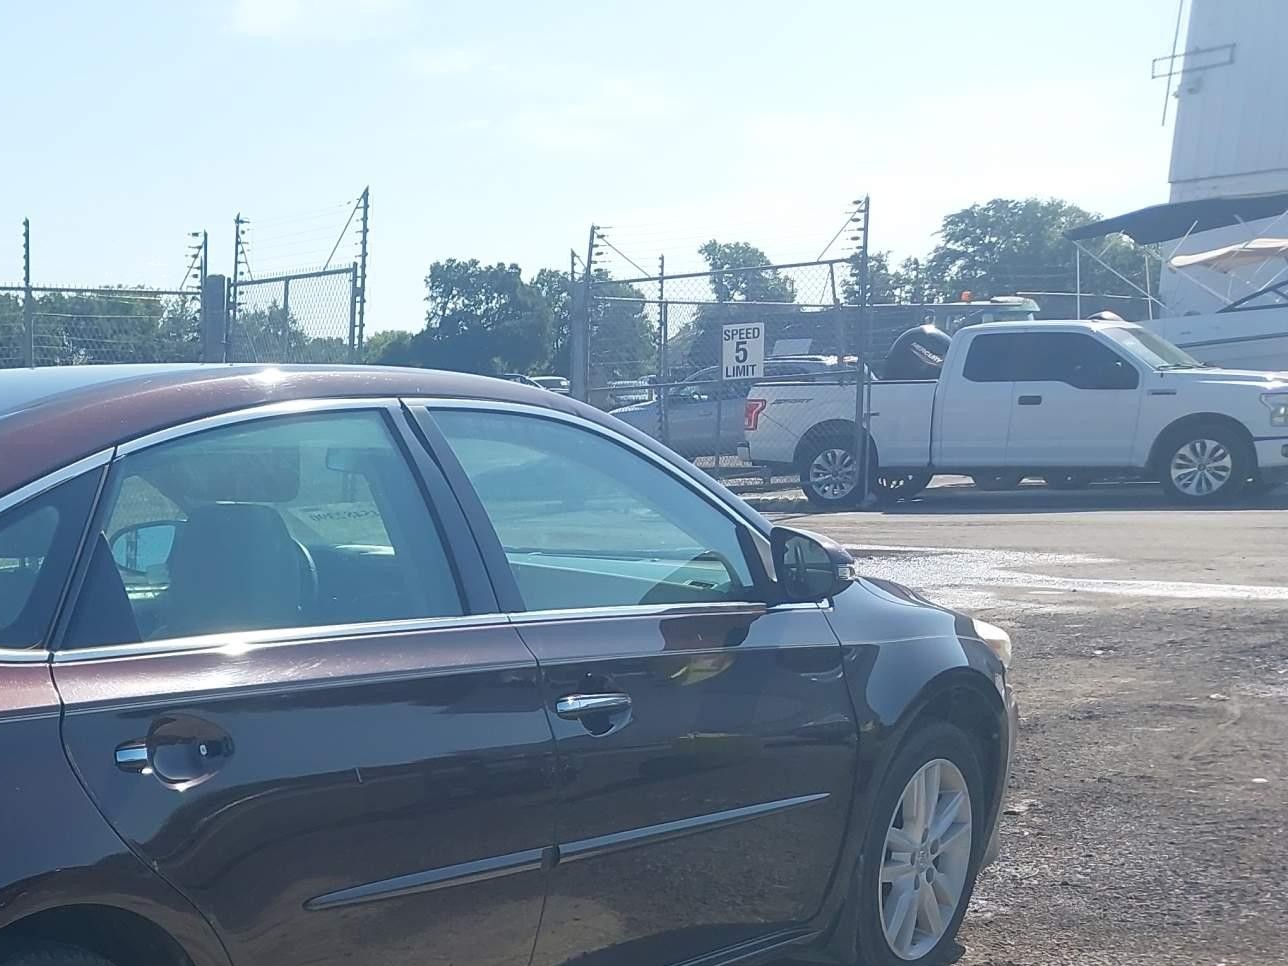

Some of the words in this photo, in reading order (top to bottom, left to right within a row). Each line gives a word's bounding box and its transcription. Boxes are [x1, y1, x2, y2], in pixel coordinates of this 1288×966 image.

[723, 327, 760, 341] SPEED
[735, 341, 748, 363] 5
[725, 364, 757, 378] LIMIT
